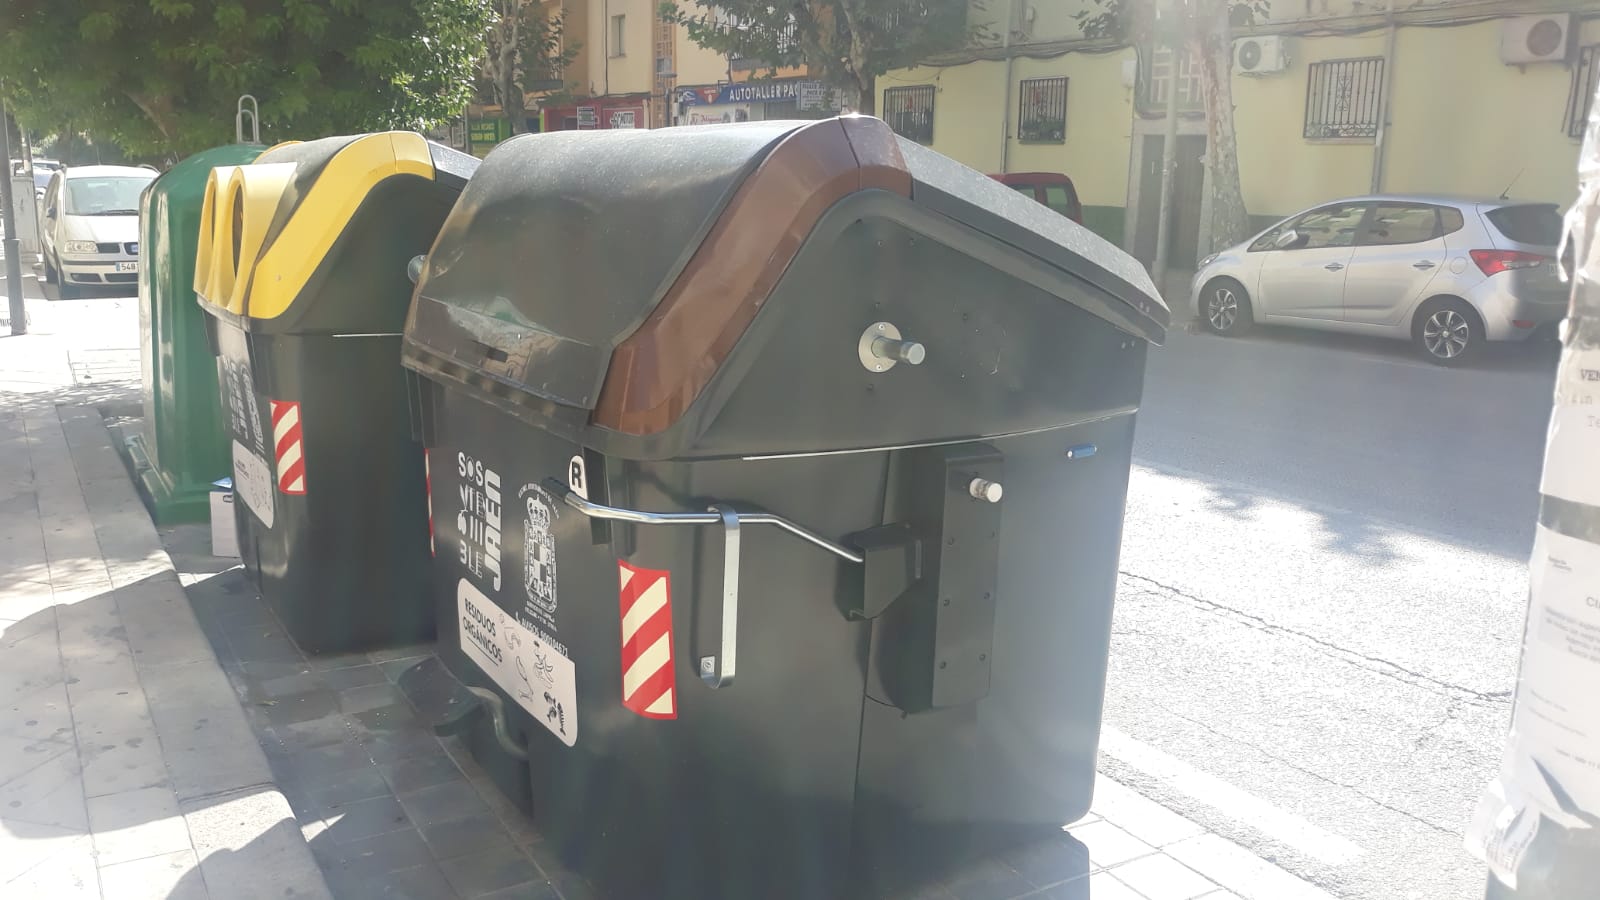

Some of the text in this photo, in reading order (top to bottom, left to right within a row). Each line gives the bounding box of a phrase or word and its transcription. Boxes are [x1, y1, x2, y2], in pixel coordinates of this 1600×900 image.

[729, 85, 781, 101] AUTOTALLER
[571, 461, 582, 489] R
[464, 598, 496, 637] RESIDUOS
[463, 616, 503, 662] ORGÁNICOS
